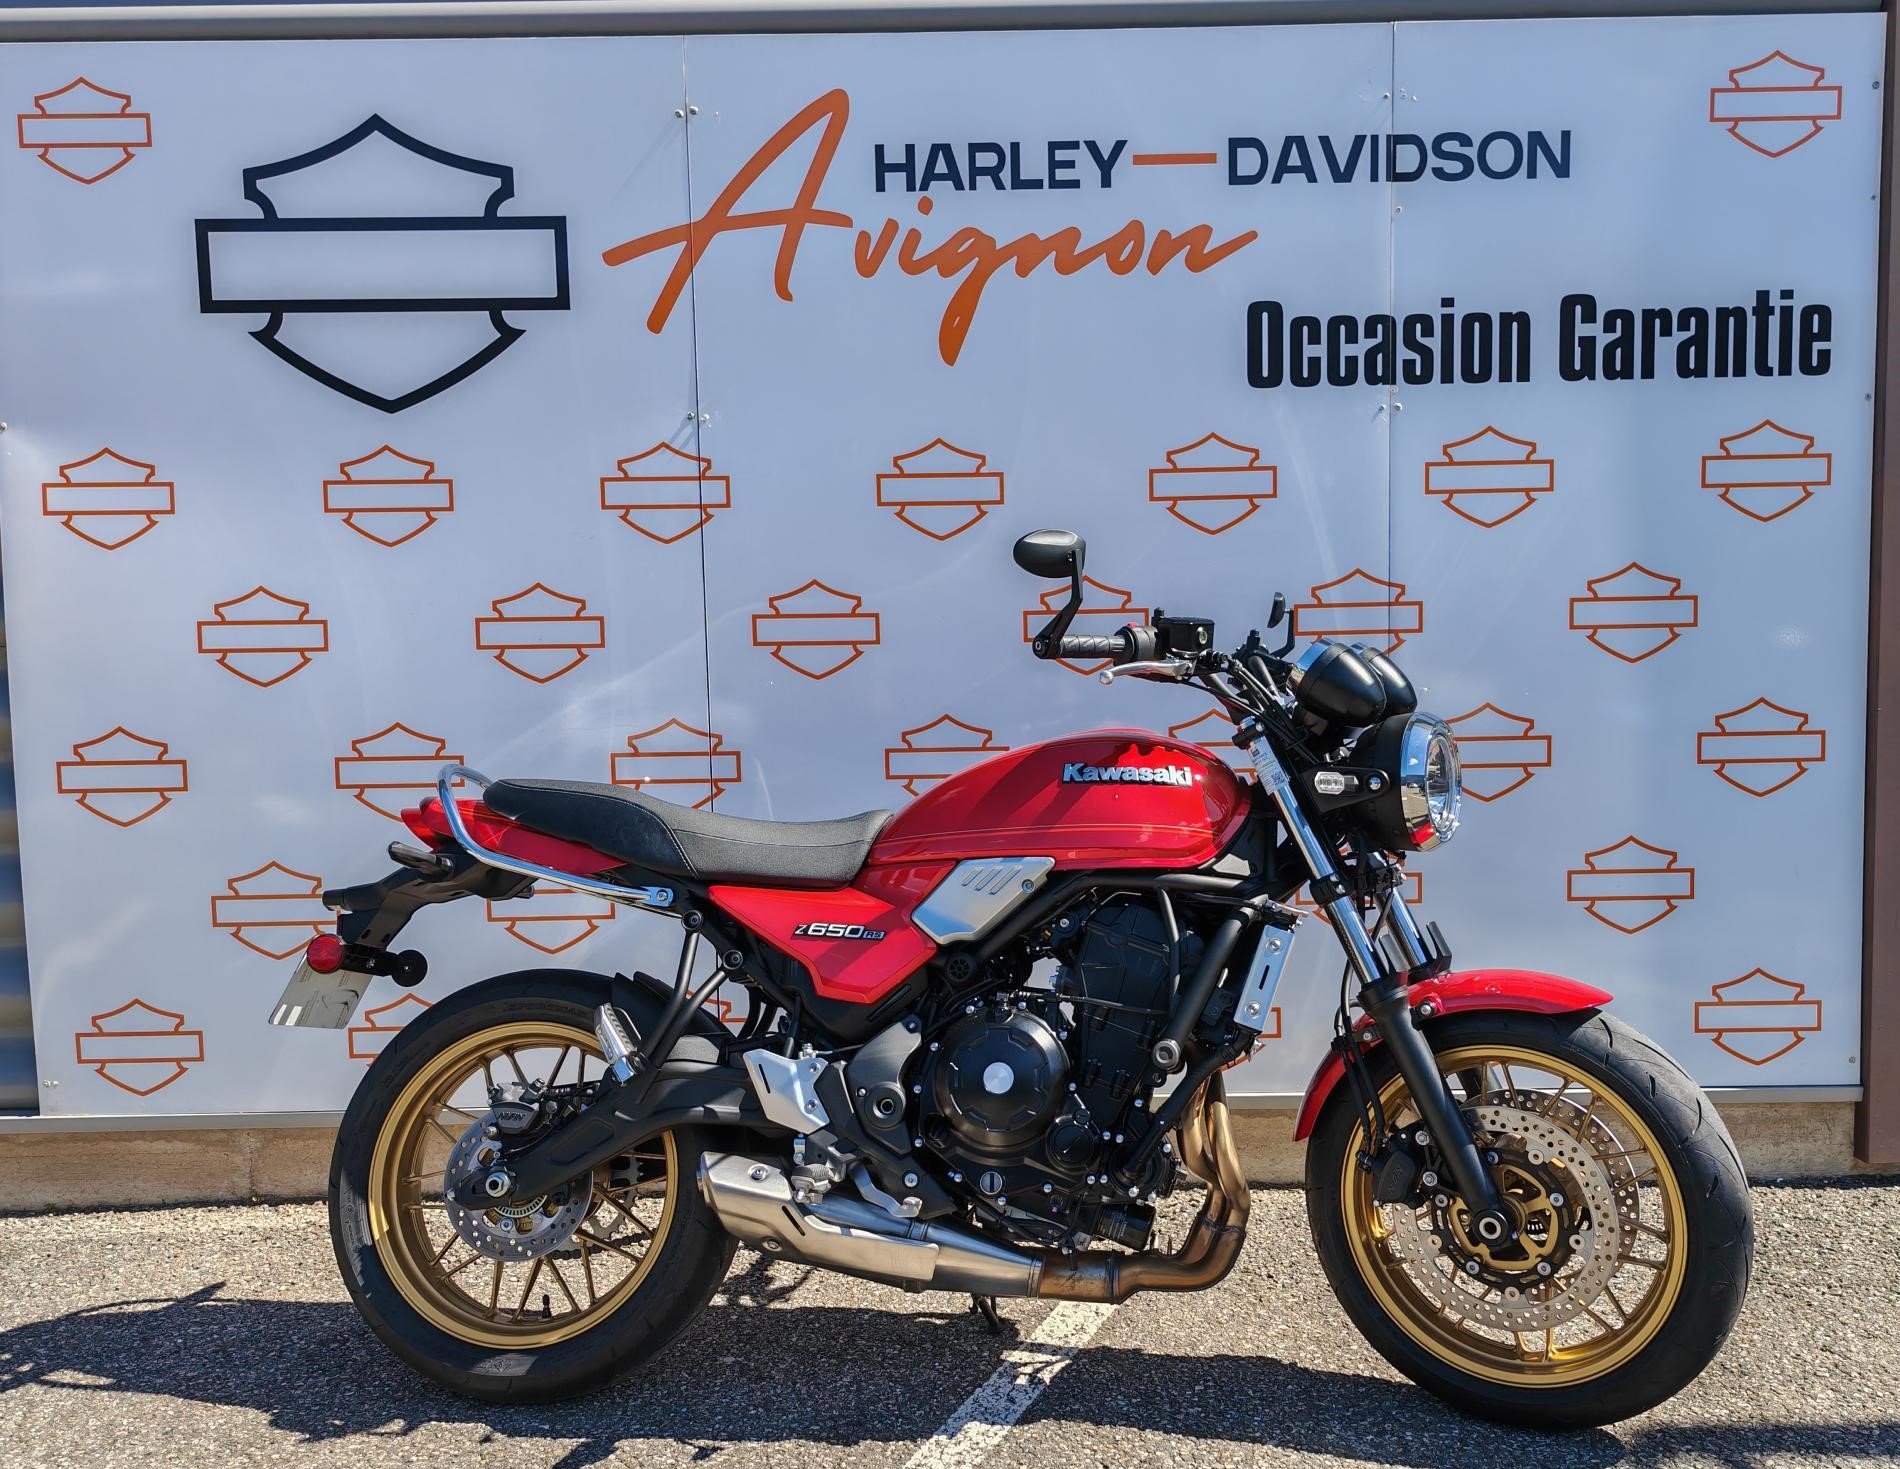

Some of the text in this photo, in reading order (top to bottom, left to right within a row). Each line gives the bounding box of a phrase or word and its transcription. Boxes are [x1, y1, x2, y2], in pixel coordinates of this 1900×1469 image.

[602, 88, 1258, 366] Avignon
[1246, 288, 1832, 389] Occasion Garantie
[1062, 762, 1193, 786] Kawasaki
